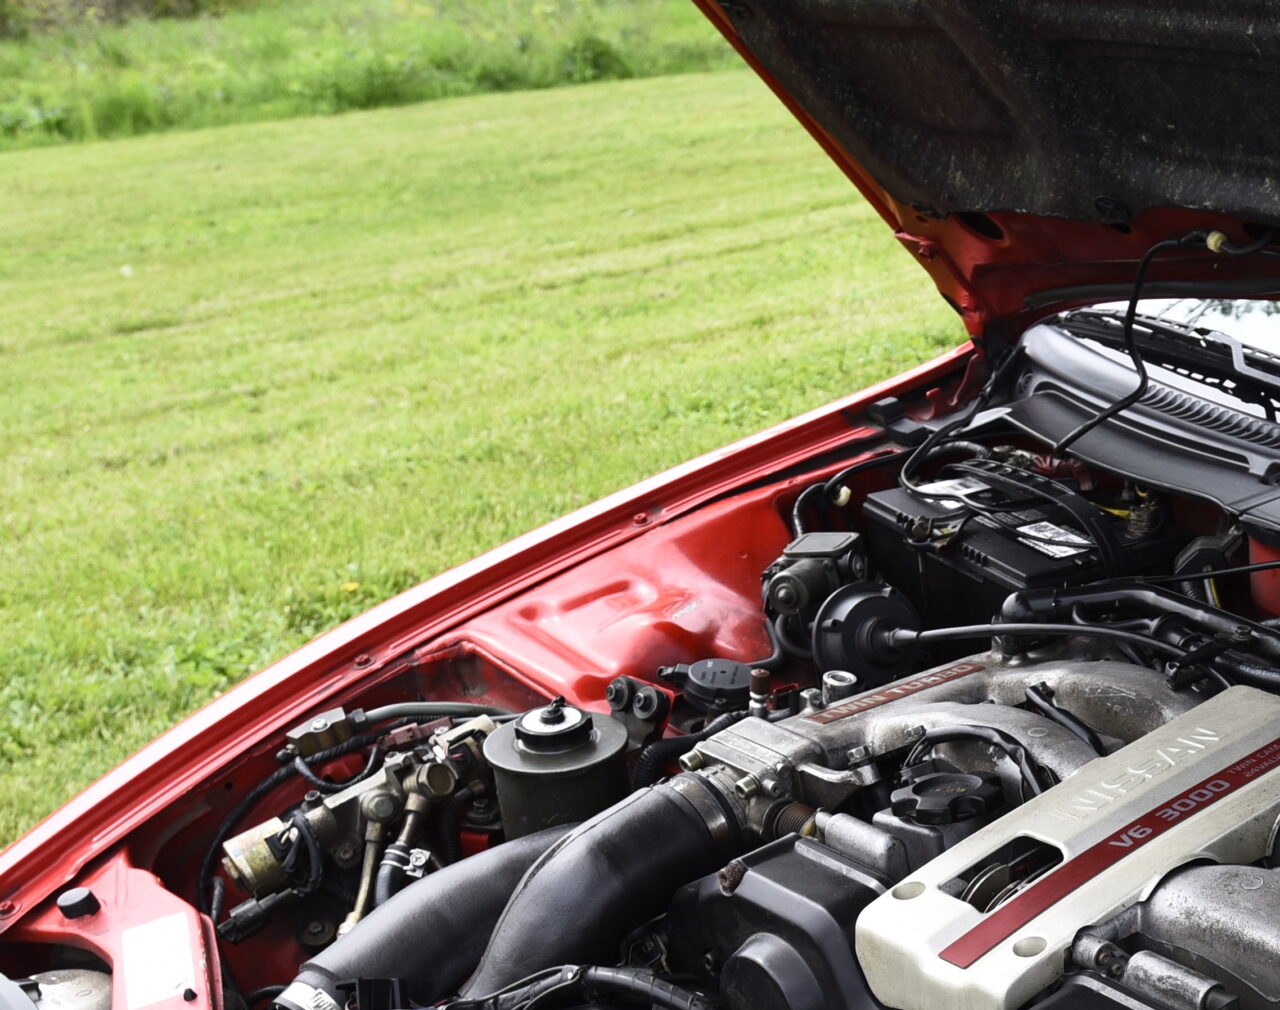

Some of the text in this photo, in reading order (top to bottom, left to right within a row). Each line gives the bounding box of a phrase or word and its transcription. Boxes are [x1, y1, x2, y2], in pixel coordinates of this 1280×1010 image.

[819, 664, 975, 718] TWIN TURBO
[1050, 727, 1219, 819] NISSAN
[1227, 759, 1254, 776] TWIN
[1109, 779, 1231, 848] V6 3000
